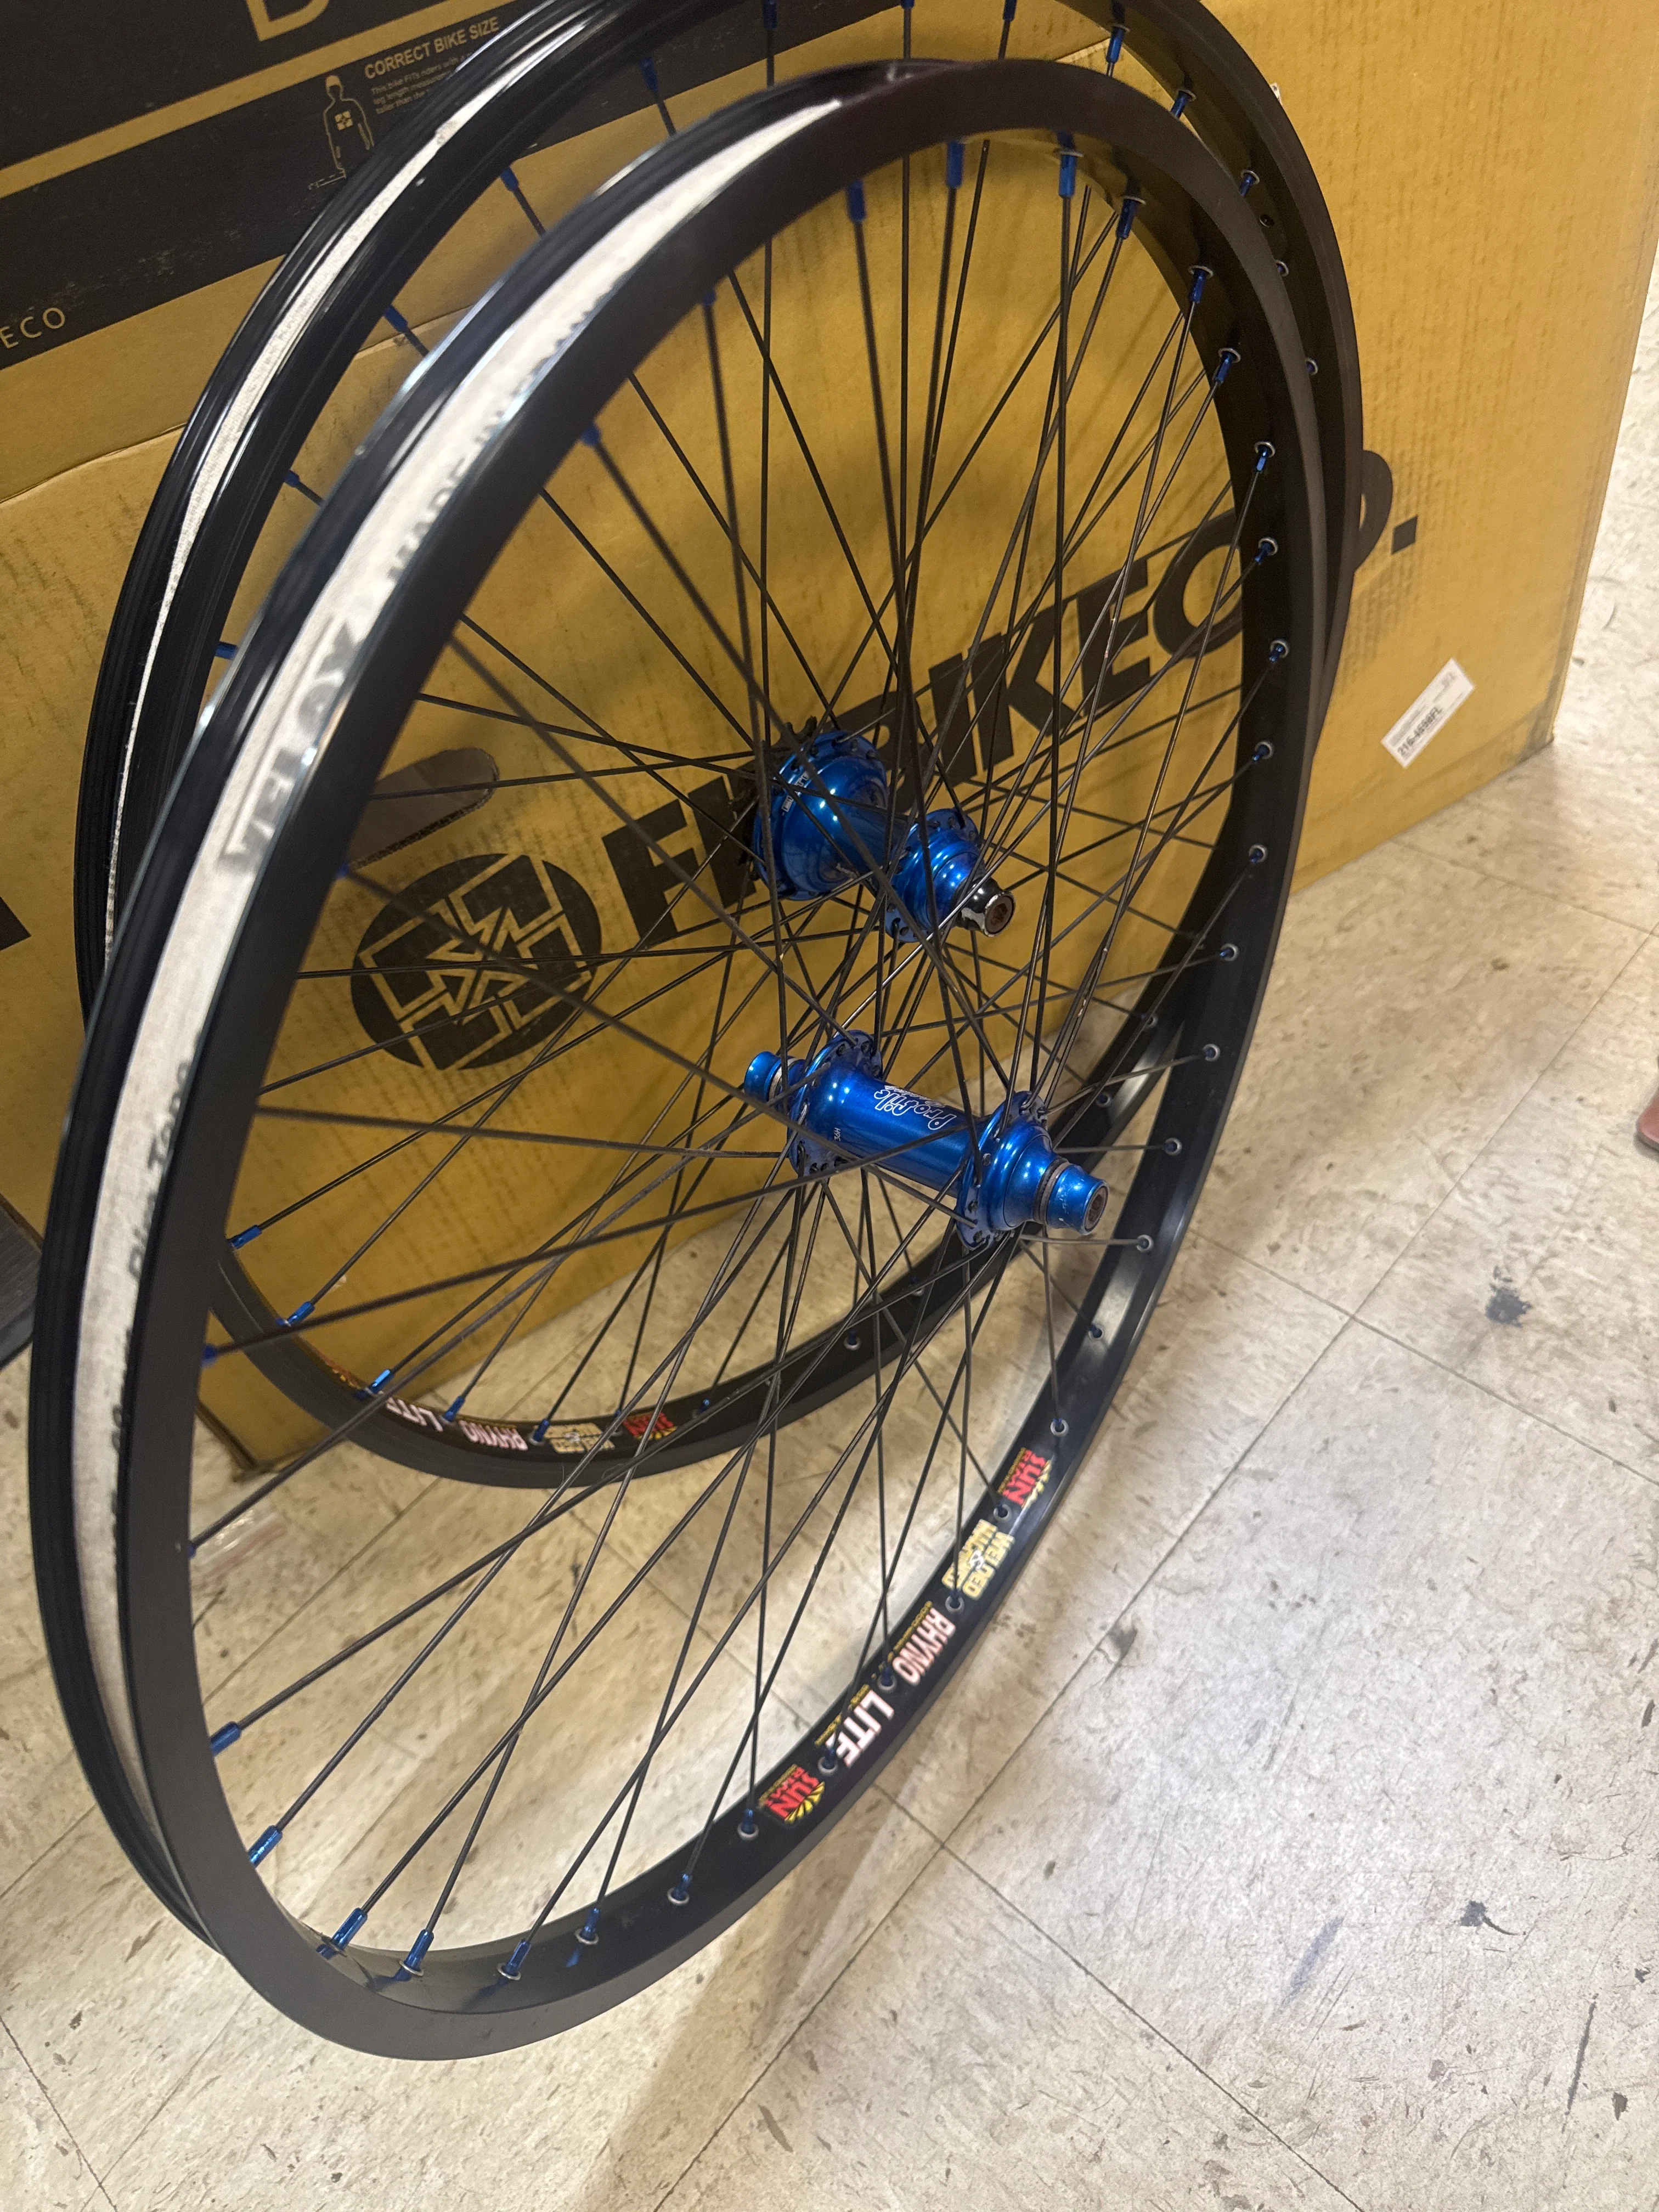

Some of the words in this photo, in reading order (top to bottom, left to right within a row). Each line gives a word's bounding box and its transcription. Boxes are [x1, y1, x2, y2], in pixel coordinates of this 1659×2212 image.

[364, 42, 431, 79] CORRECT
[434, 29, 467, 53] BIKE
[469, 16, 500, 40] SIZE
[874, 1089, 957, 1130] Profile
[1007, 1453, 1047, 1506] SUN
[893, 1607, 956, 1685] RHYNO
[826, 1689, 895, 1767] LITE
[768, 1774, 820, 1820] SUN
